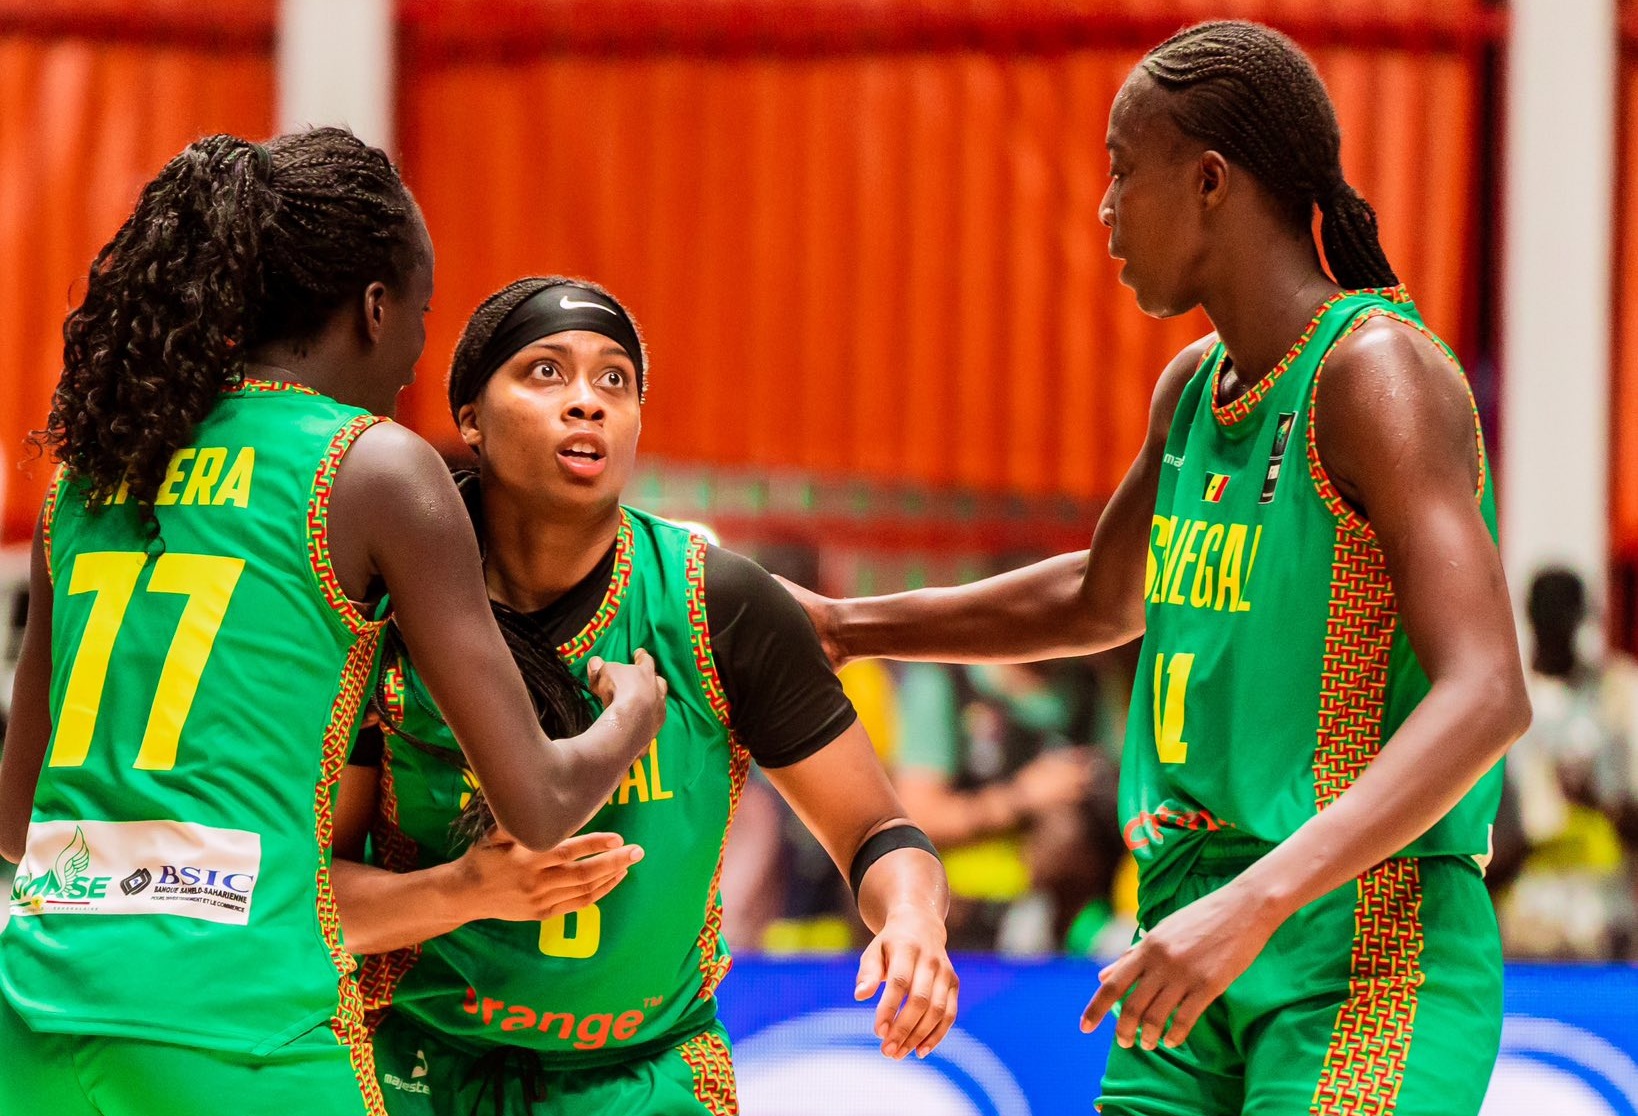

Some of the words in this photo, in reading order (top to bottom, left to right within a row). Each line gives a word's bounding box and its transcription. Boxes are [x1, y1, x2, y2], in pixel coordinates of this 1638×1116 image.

[1145, 514, 1262, 612] SNEGAL
[48, 551, 246, 771] 77
[154, 886, 180, 894] BANQUE
[158, 865, 254, 893] BSIC
[384, 1074, 431, 1095] majeste
